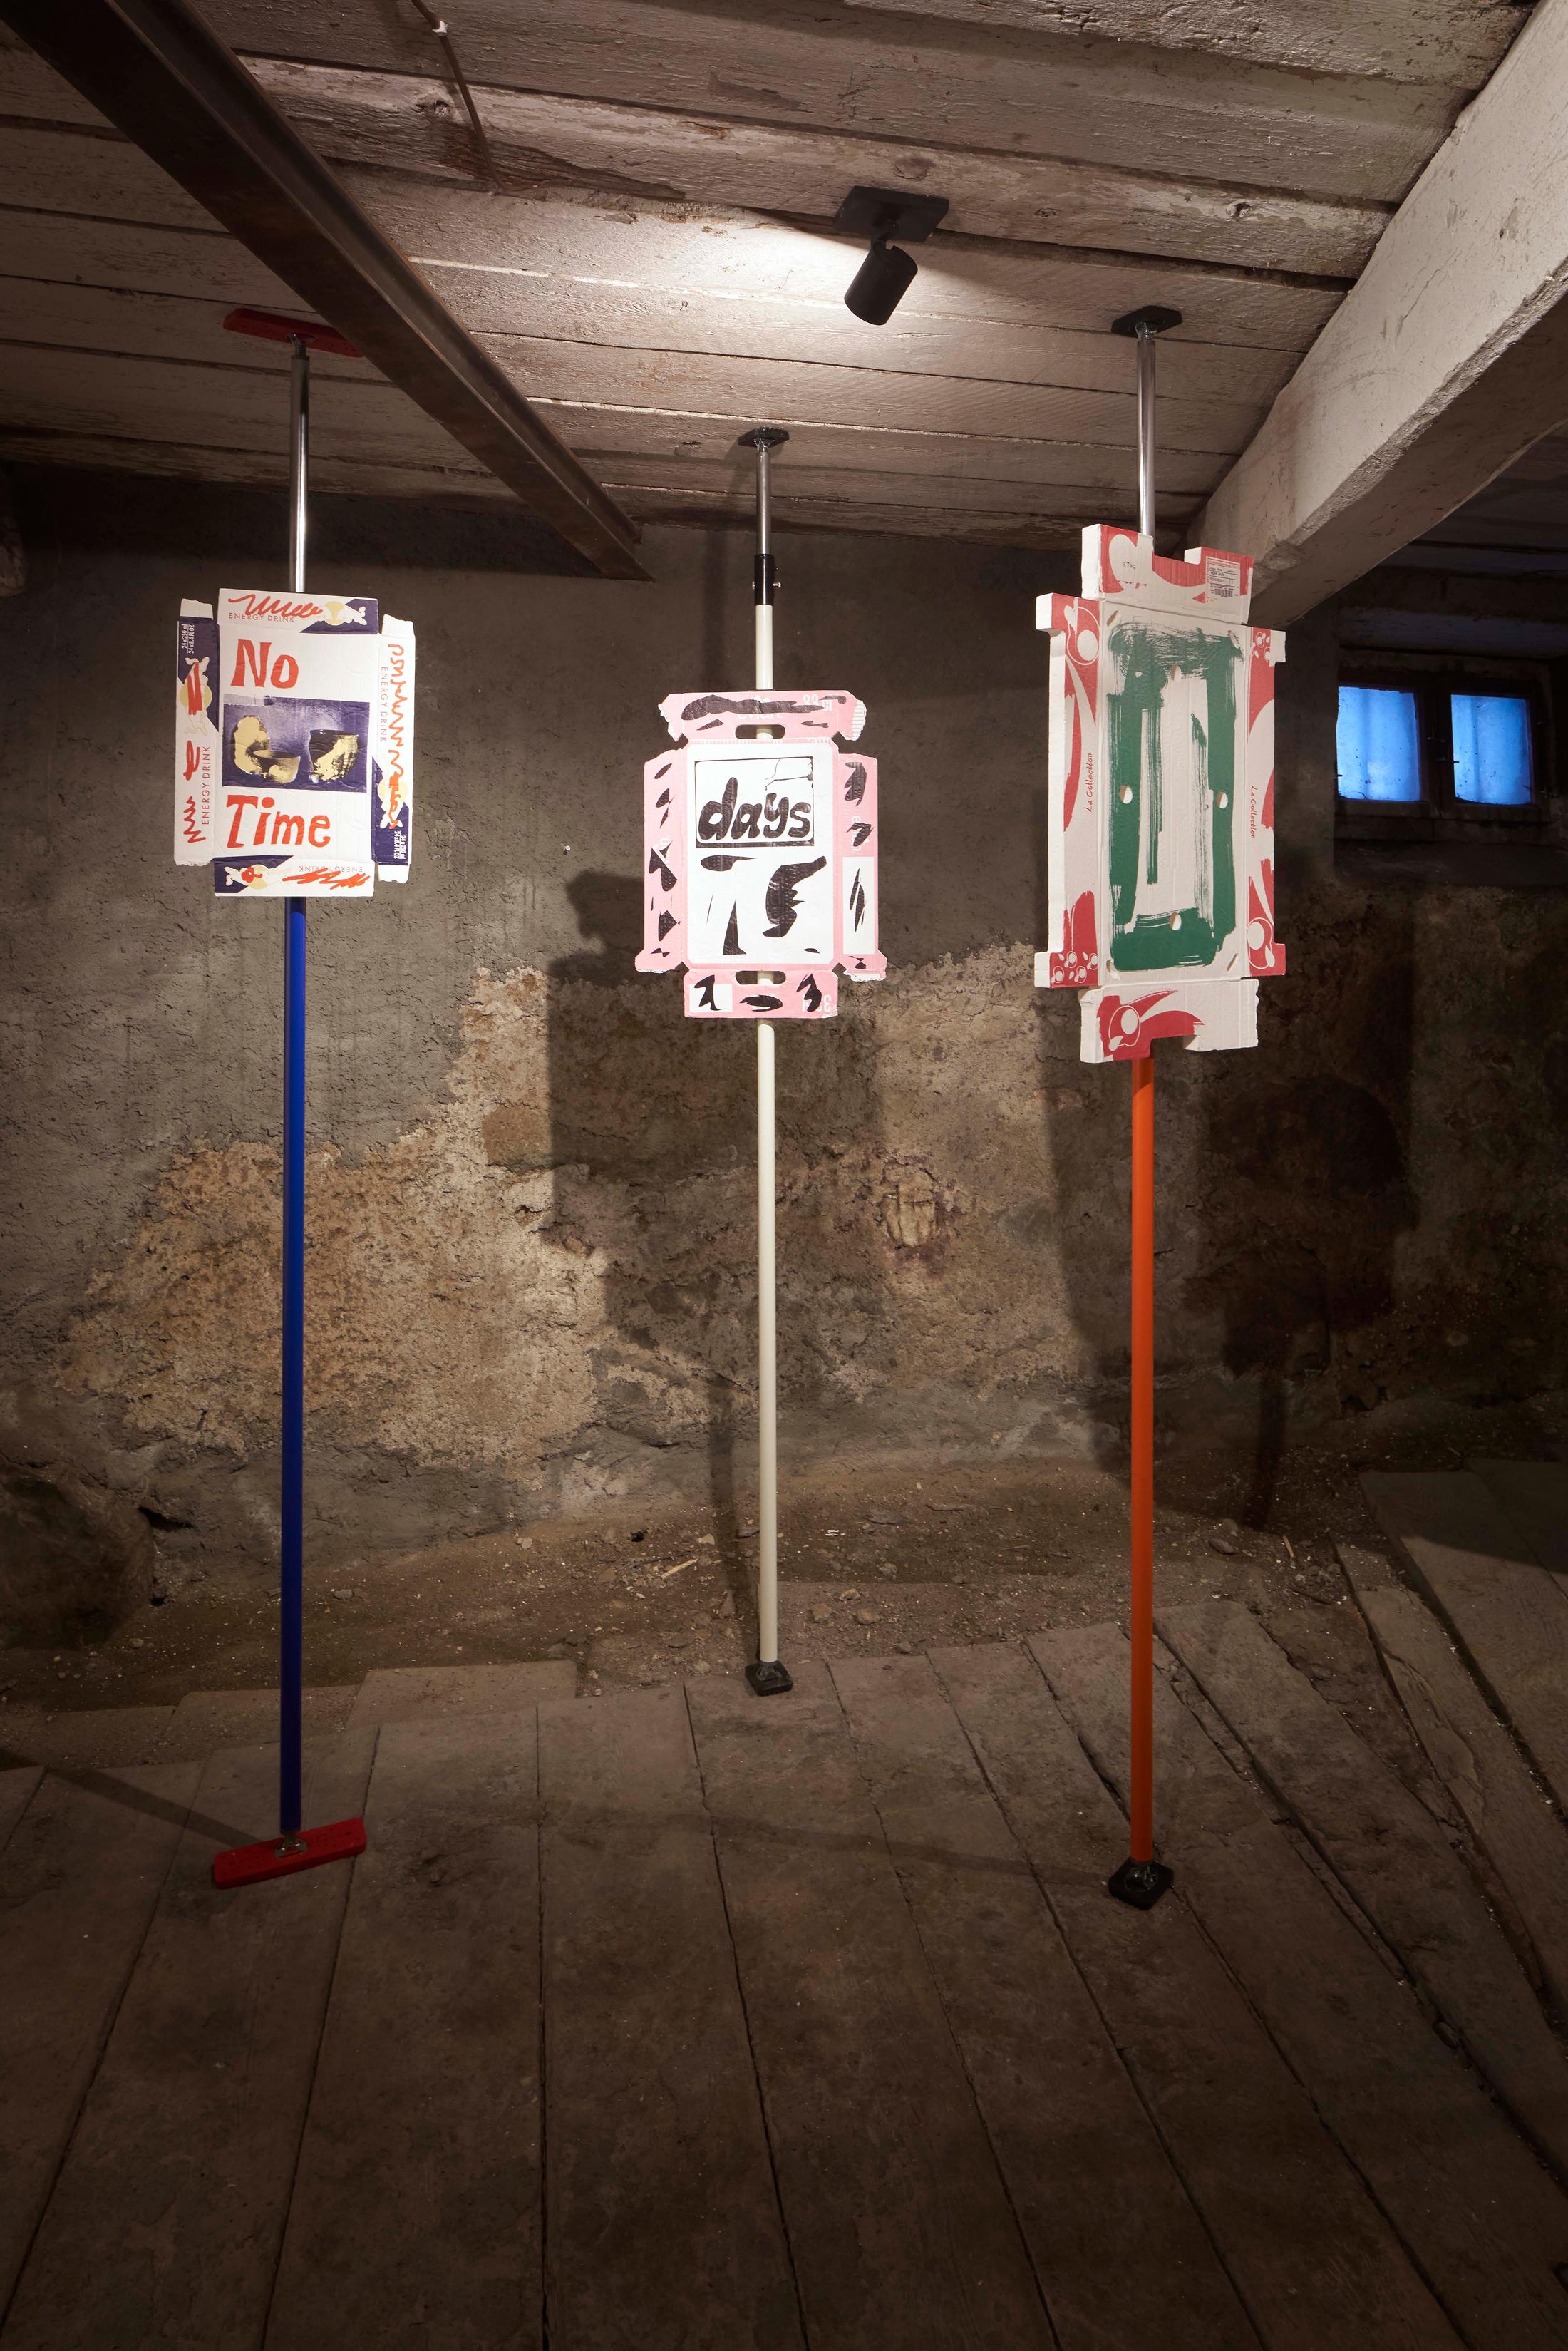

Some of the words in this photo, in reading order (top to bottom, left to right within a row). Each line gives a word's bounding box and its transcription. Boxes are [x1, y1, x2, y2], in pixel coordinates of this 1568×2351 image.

[228, 612, 264, 621] ENERGY
[267, 614, 294, 623] DRINK
[230, 639, 299, 689] No
[202, 746, 211, 778] DRINK
[201, 783, 210, 825] ENERGY
[698, 776, 811, 841] days
[1084, 800, 1093, 813] La
[1250, 786, 1259, 796] La
[225, 794, 331, 849] Time
